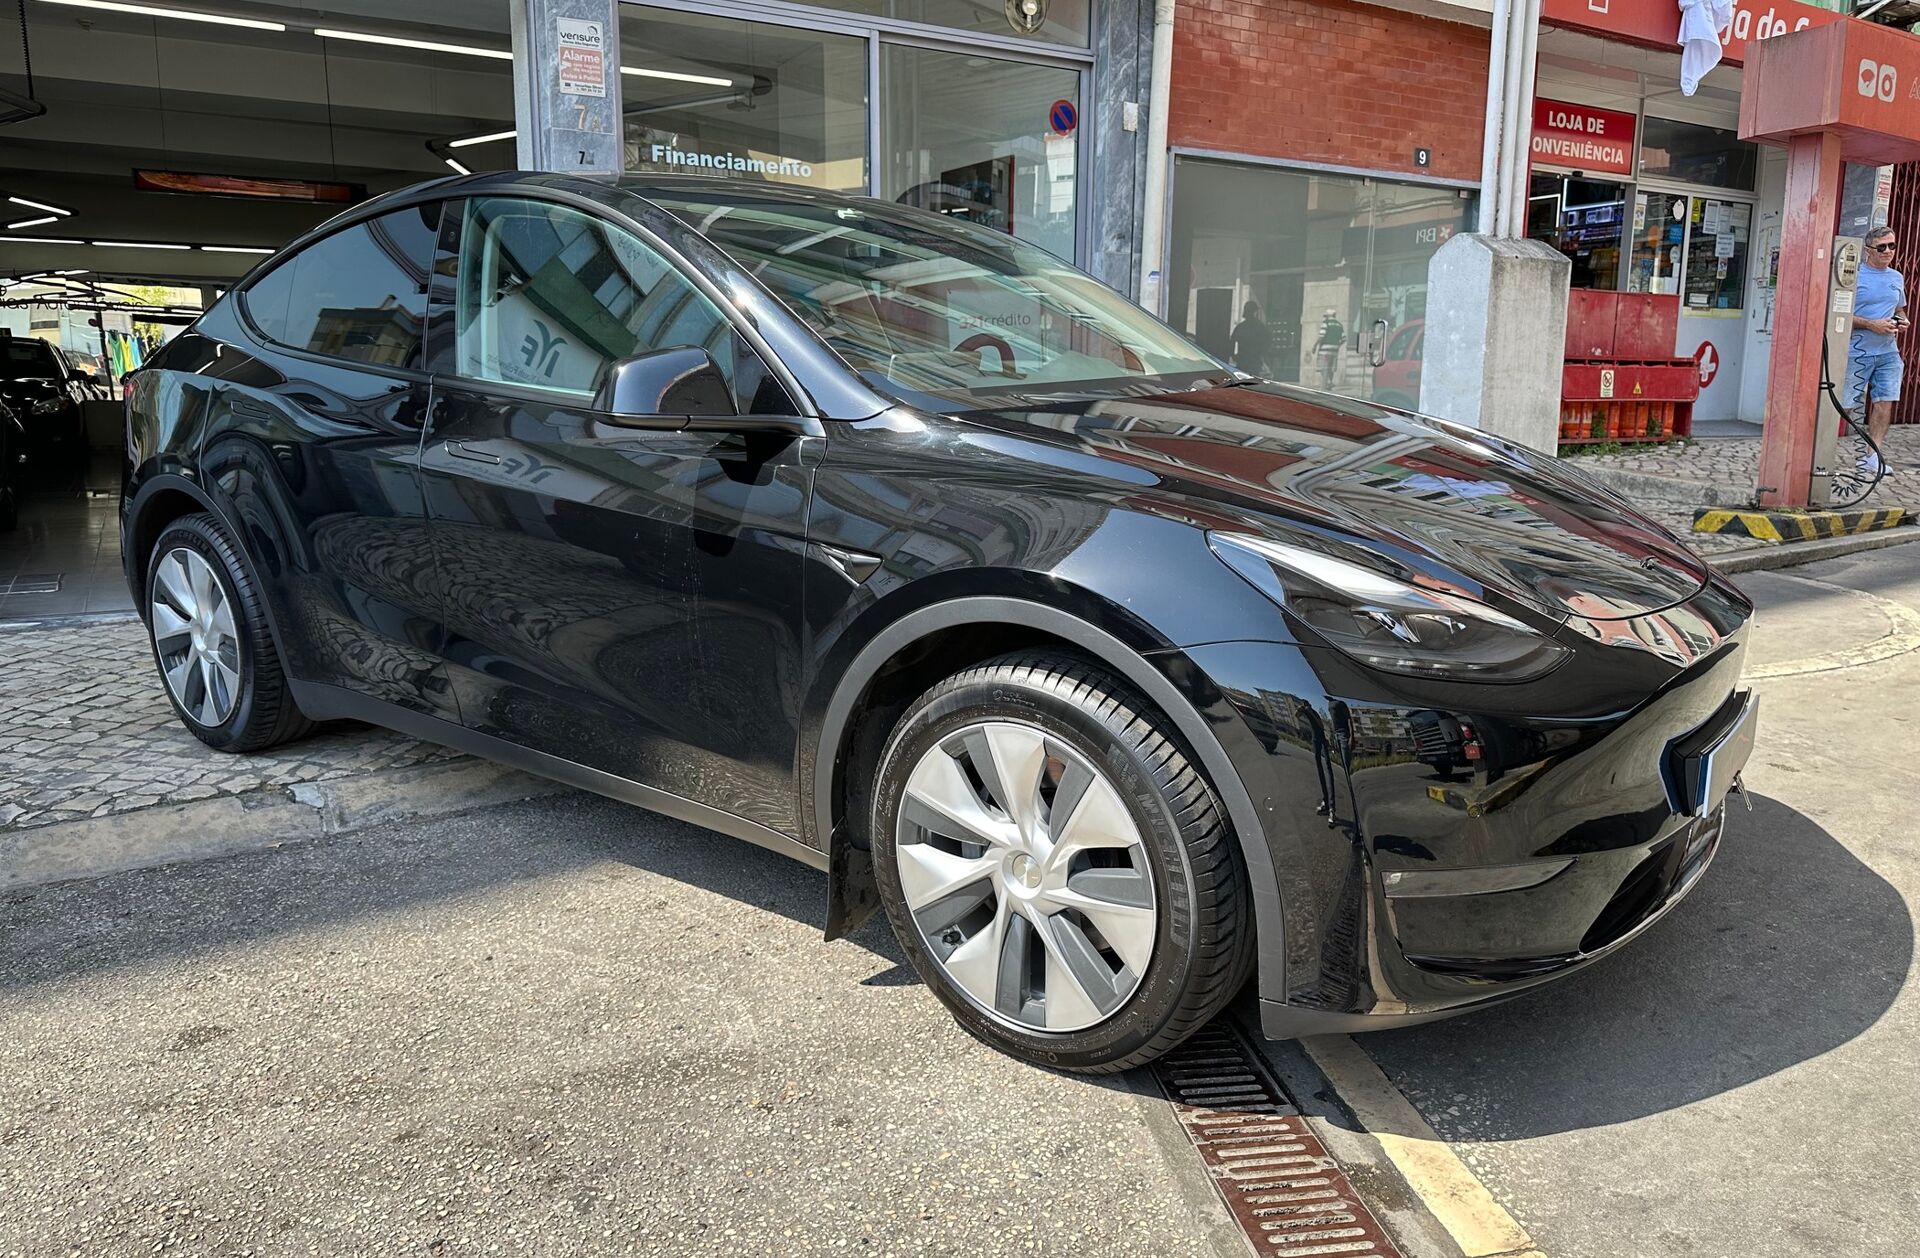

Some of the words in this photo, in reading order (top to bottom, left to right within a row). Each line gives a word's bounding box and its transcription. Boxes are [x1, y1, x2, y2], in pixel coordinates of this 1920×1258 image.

[1721, 0, 1752, 46] ja
[560, 32, 600, 43] verisure
[562, 50, 600, 63] Alarme
[1548, 110, 1583, 131] LOJA
[1586, 117, 1605, 134] DE
[652, 144, 812, 178] Financiamento
[1419, 150, 1427, 164] 9
[1532, 136, 1624, 164] ONVENIÊNCIA
[1137, 793, 1191, 939] MICHELIN
